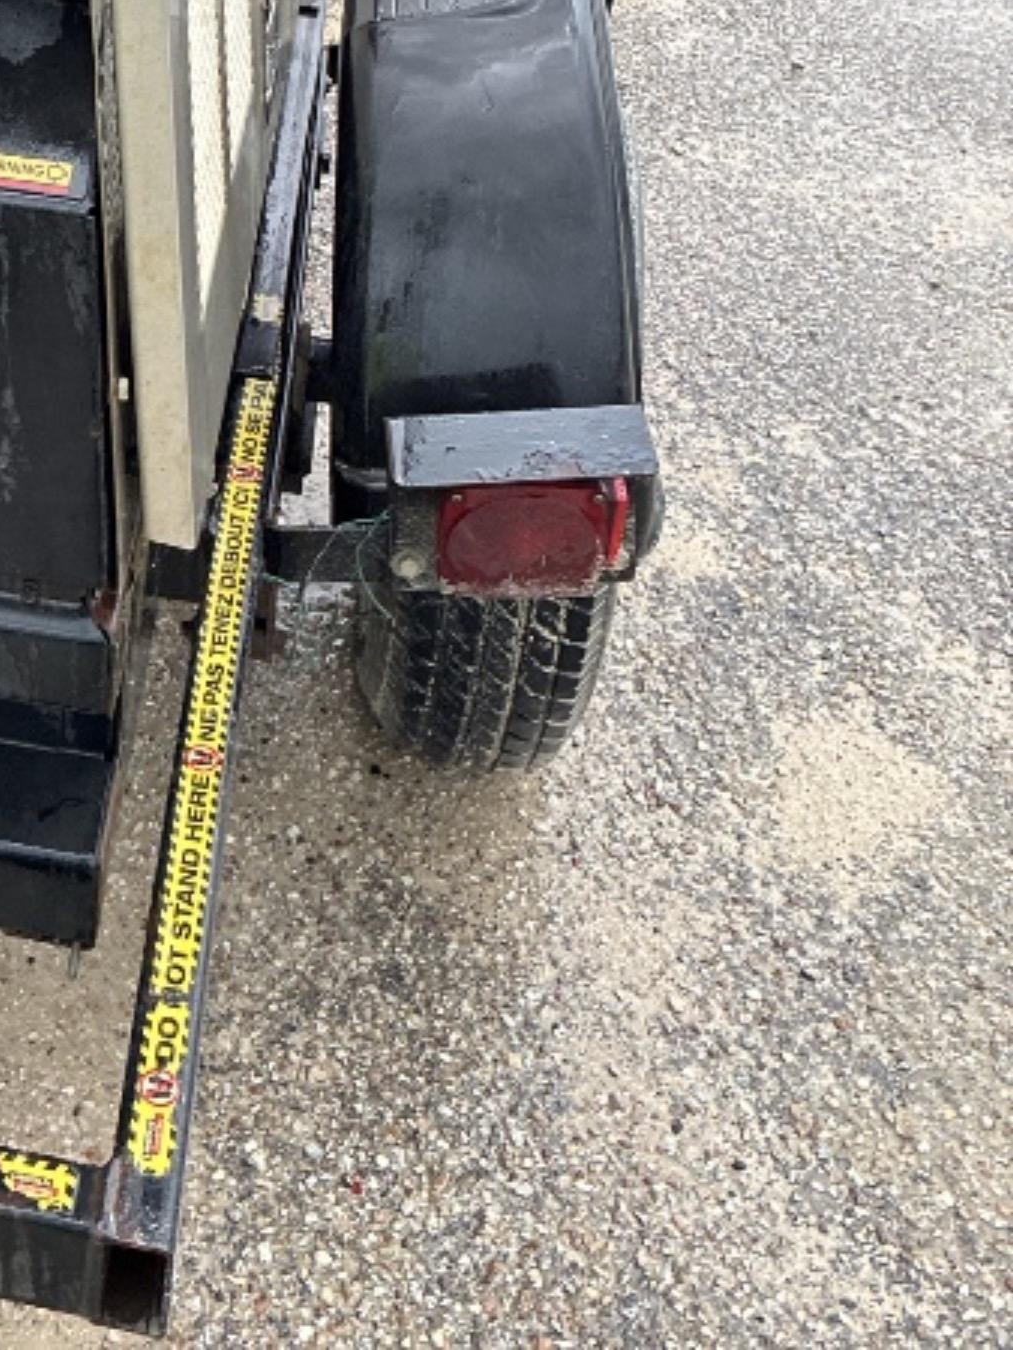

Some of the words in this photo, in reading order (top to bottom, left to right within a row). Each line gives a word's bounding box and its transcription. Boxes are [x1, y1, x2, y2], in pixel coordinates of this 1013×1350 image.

[233, 486, 249, 510] ICI
[220, 514, 245, 588] DEBOUT
[209, 593, 234, 657] TENEZ
[203, 663, 225, 705] PAS
[185, 773, 209, 841] HERE
[172, 848, 200, 940] STAND
[155, 1016, 180, 1063] DO
